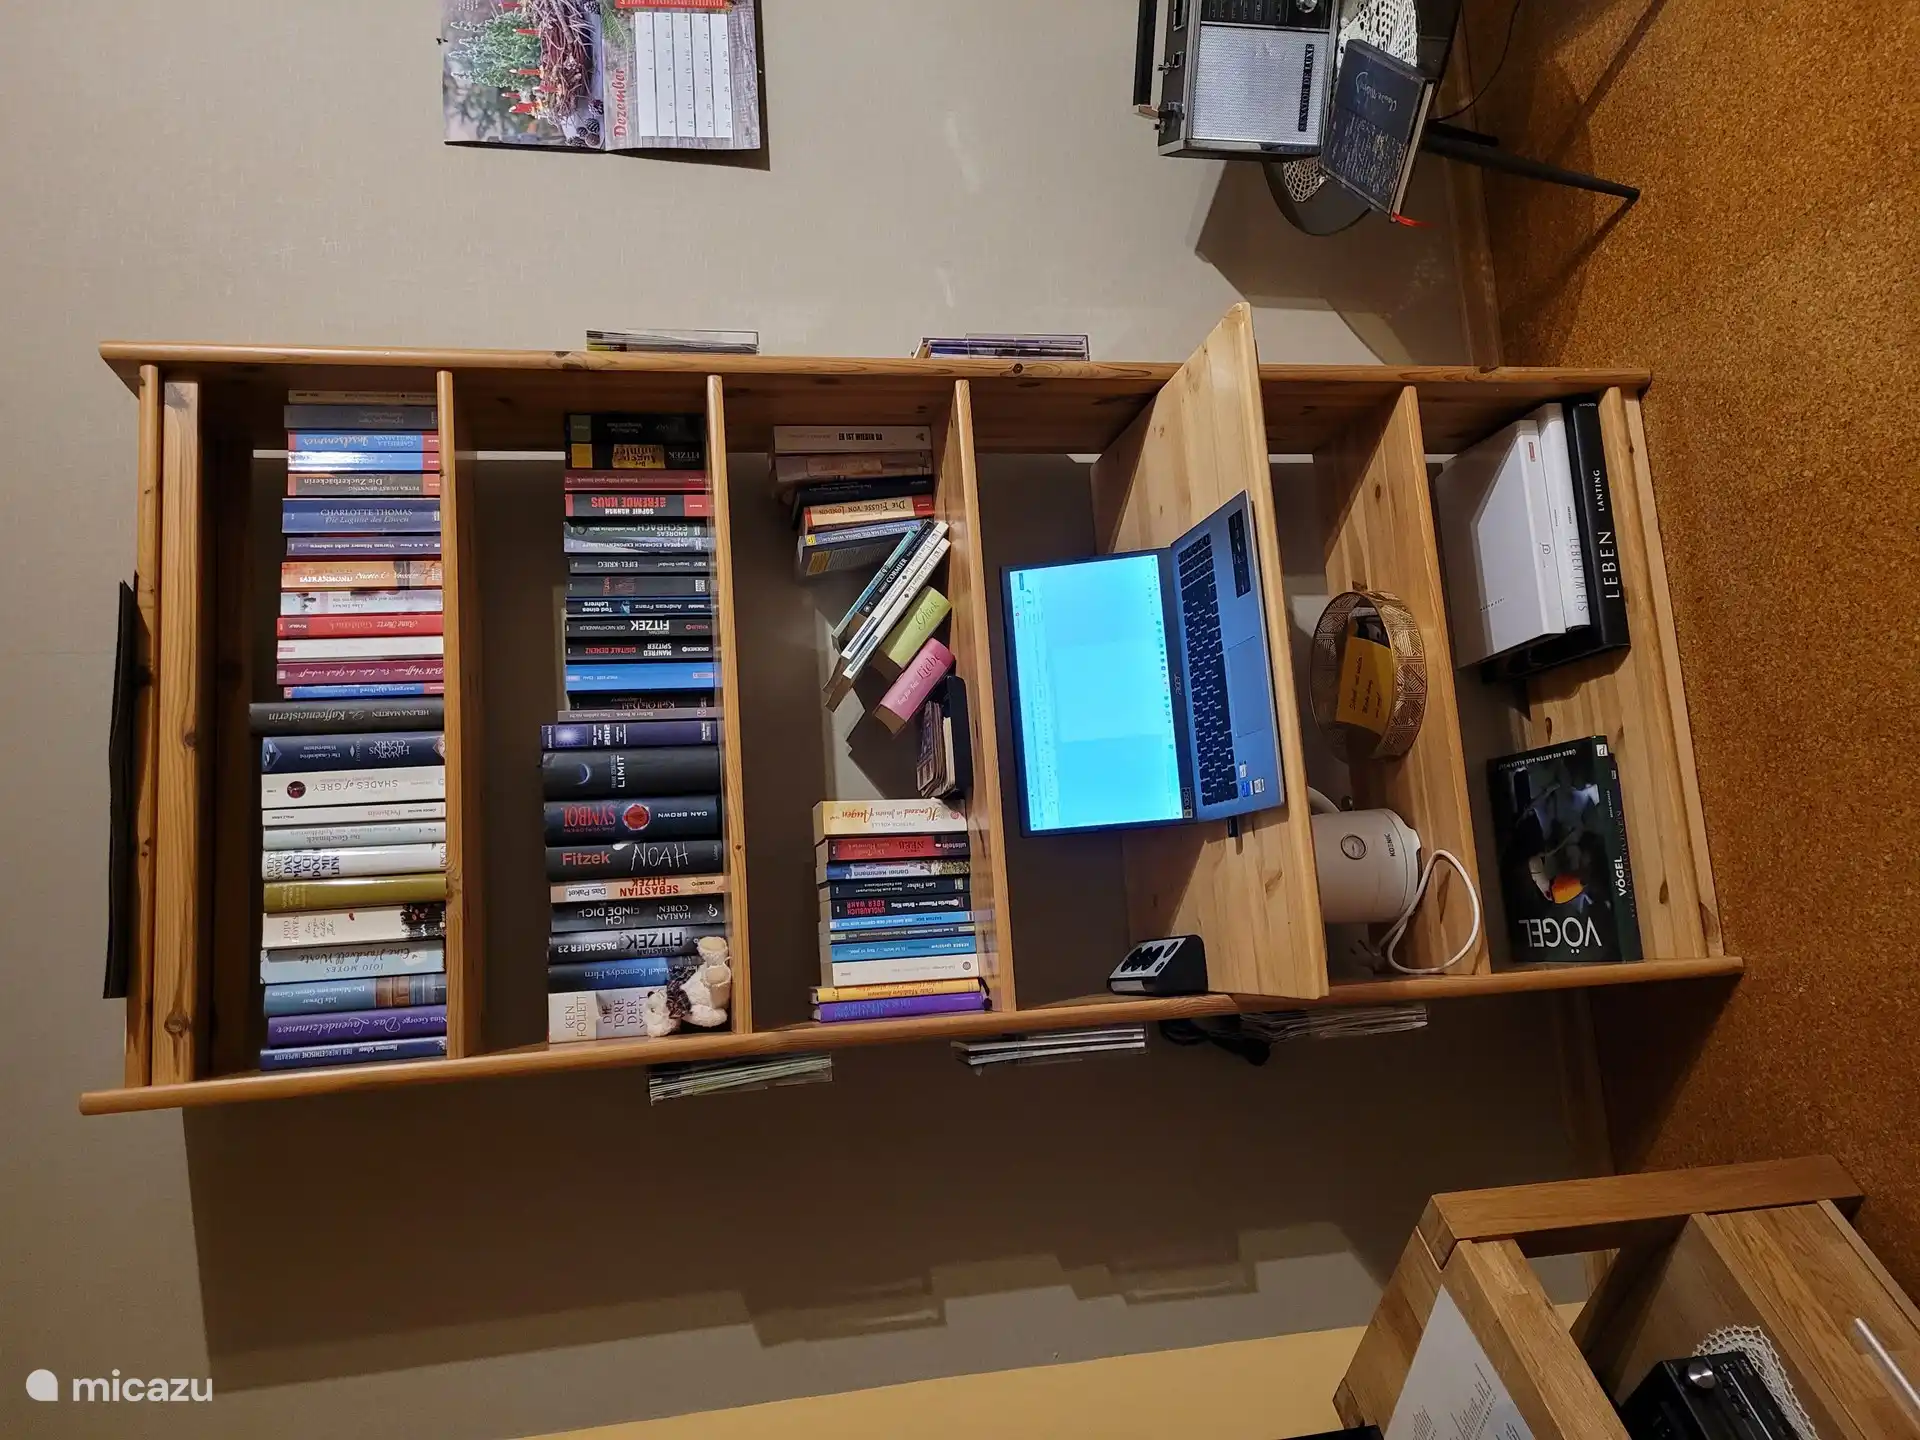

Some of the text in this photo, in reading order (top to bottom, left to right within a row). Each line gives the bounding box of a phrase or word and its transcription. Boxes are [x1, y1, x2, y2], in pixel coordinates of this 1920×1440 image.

[1299, 44, 1314, 131] SENATOR DE LUXE
[612, 69, 627, 136] Dezember
[1593, 470, 1605, 511] LANTING
[591, 497, 659, 507] FREMDE HAUS
[864, 502, 888, 511] FLÜSSE
[892, 500, 905, 509] DIE
[819, 506, 845, 515] LONDON
[1569, 537, 1584, 571] LEBEN
[886, 558, 907, 584] CORMIER
[1598, 531, 1620, 598] LEBEN
[1574, 576, 1586, 588] IM
[1576, 595, 1588, 611] EIS
[630, 620, 669, 630] FITZEK
[917, 653, 941, 678] Liebe
[1175, 674, 1183, 696] acer
[269, 711, 345, 722] Kaffeemeisterin
[368, 746, 410, 754] HIGGINS
[374, 740, 405, 748] CLARK
[1536, 753, 1552, 762] ARTEN
[1562, 748, 1576, 757] ÜBER
[617, 755, 625, 787] LIMIT
[314, 783, 341, 791] GREY
[344, 780, 354, 790] of
[357, 779, 398, 788] SHADES
[562, 805, 616, 827] SYMBOL
[842, 808, 873, 822] Augen
[903, 807, 939, 820] Horizont
[898, 840, 924, 849] NEEB
[562, 842, 689, 871] Fitzek NOAH
[284, 855, 292, 874] DAS
[632, 877, 666, 886] FITZEK
[1614, 856, 1627, 896] VÖGEL
[620, 885, 678, 896] SEBASTIAN
[659, 905, 688, 913] COBEN
[847, 907, 885, 915] UNGLAUBLICH
[606, 916, 625, 925] ICH
[1518, 916, 1602, 954] VÖGEL
[558, 932, 682, 953] FITZEK PASSAGIER 23
[299, 947, 409, 964] Eine Handvoll Worte
[325, 965, 358, 973] MOYES
[585, 968, 646, 979] Kennedys Hirn
[565, 1006, 575, 1028] KEN
[576, 996, 586, 1037] FOLLETT
[602, 1004, 612, 1024] DIE
[614, 999, 624, 1028] TORE
[627, 1000, 637, 1024] DER
[276, 1017, 370, 1035] Lavendelzimmer
[373, 1017, 400, 1032] Das
[301, 1049, 341, 1058] ENERGETHISCHE
[377, 1044, 397, 1052] Hermann
[274, 1052, 300, 1060] IMPERATIV
